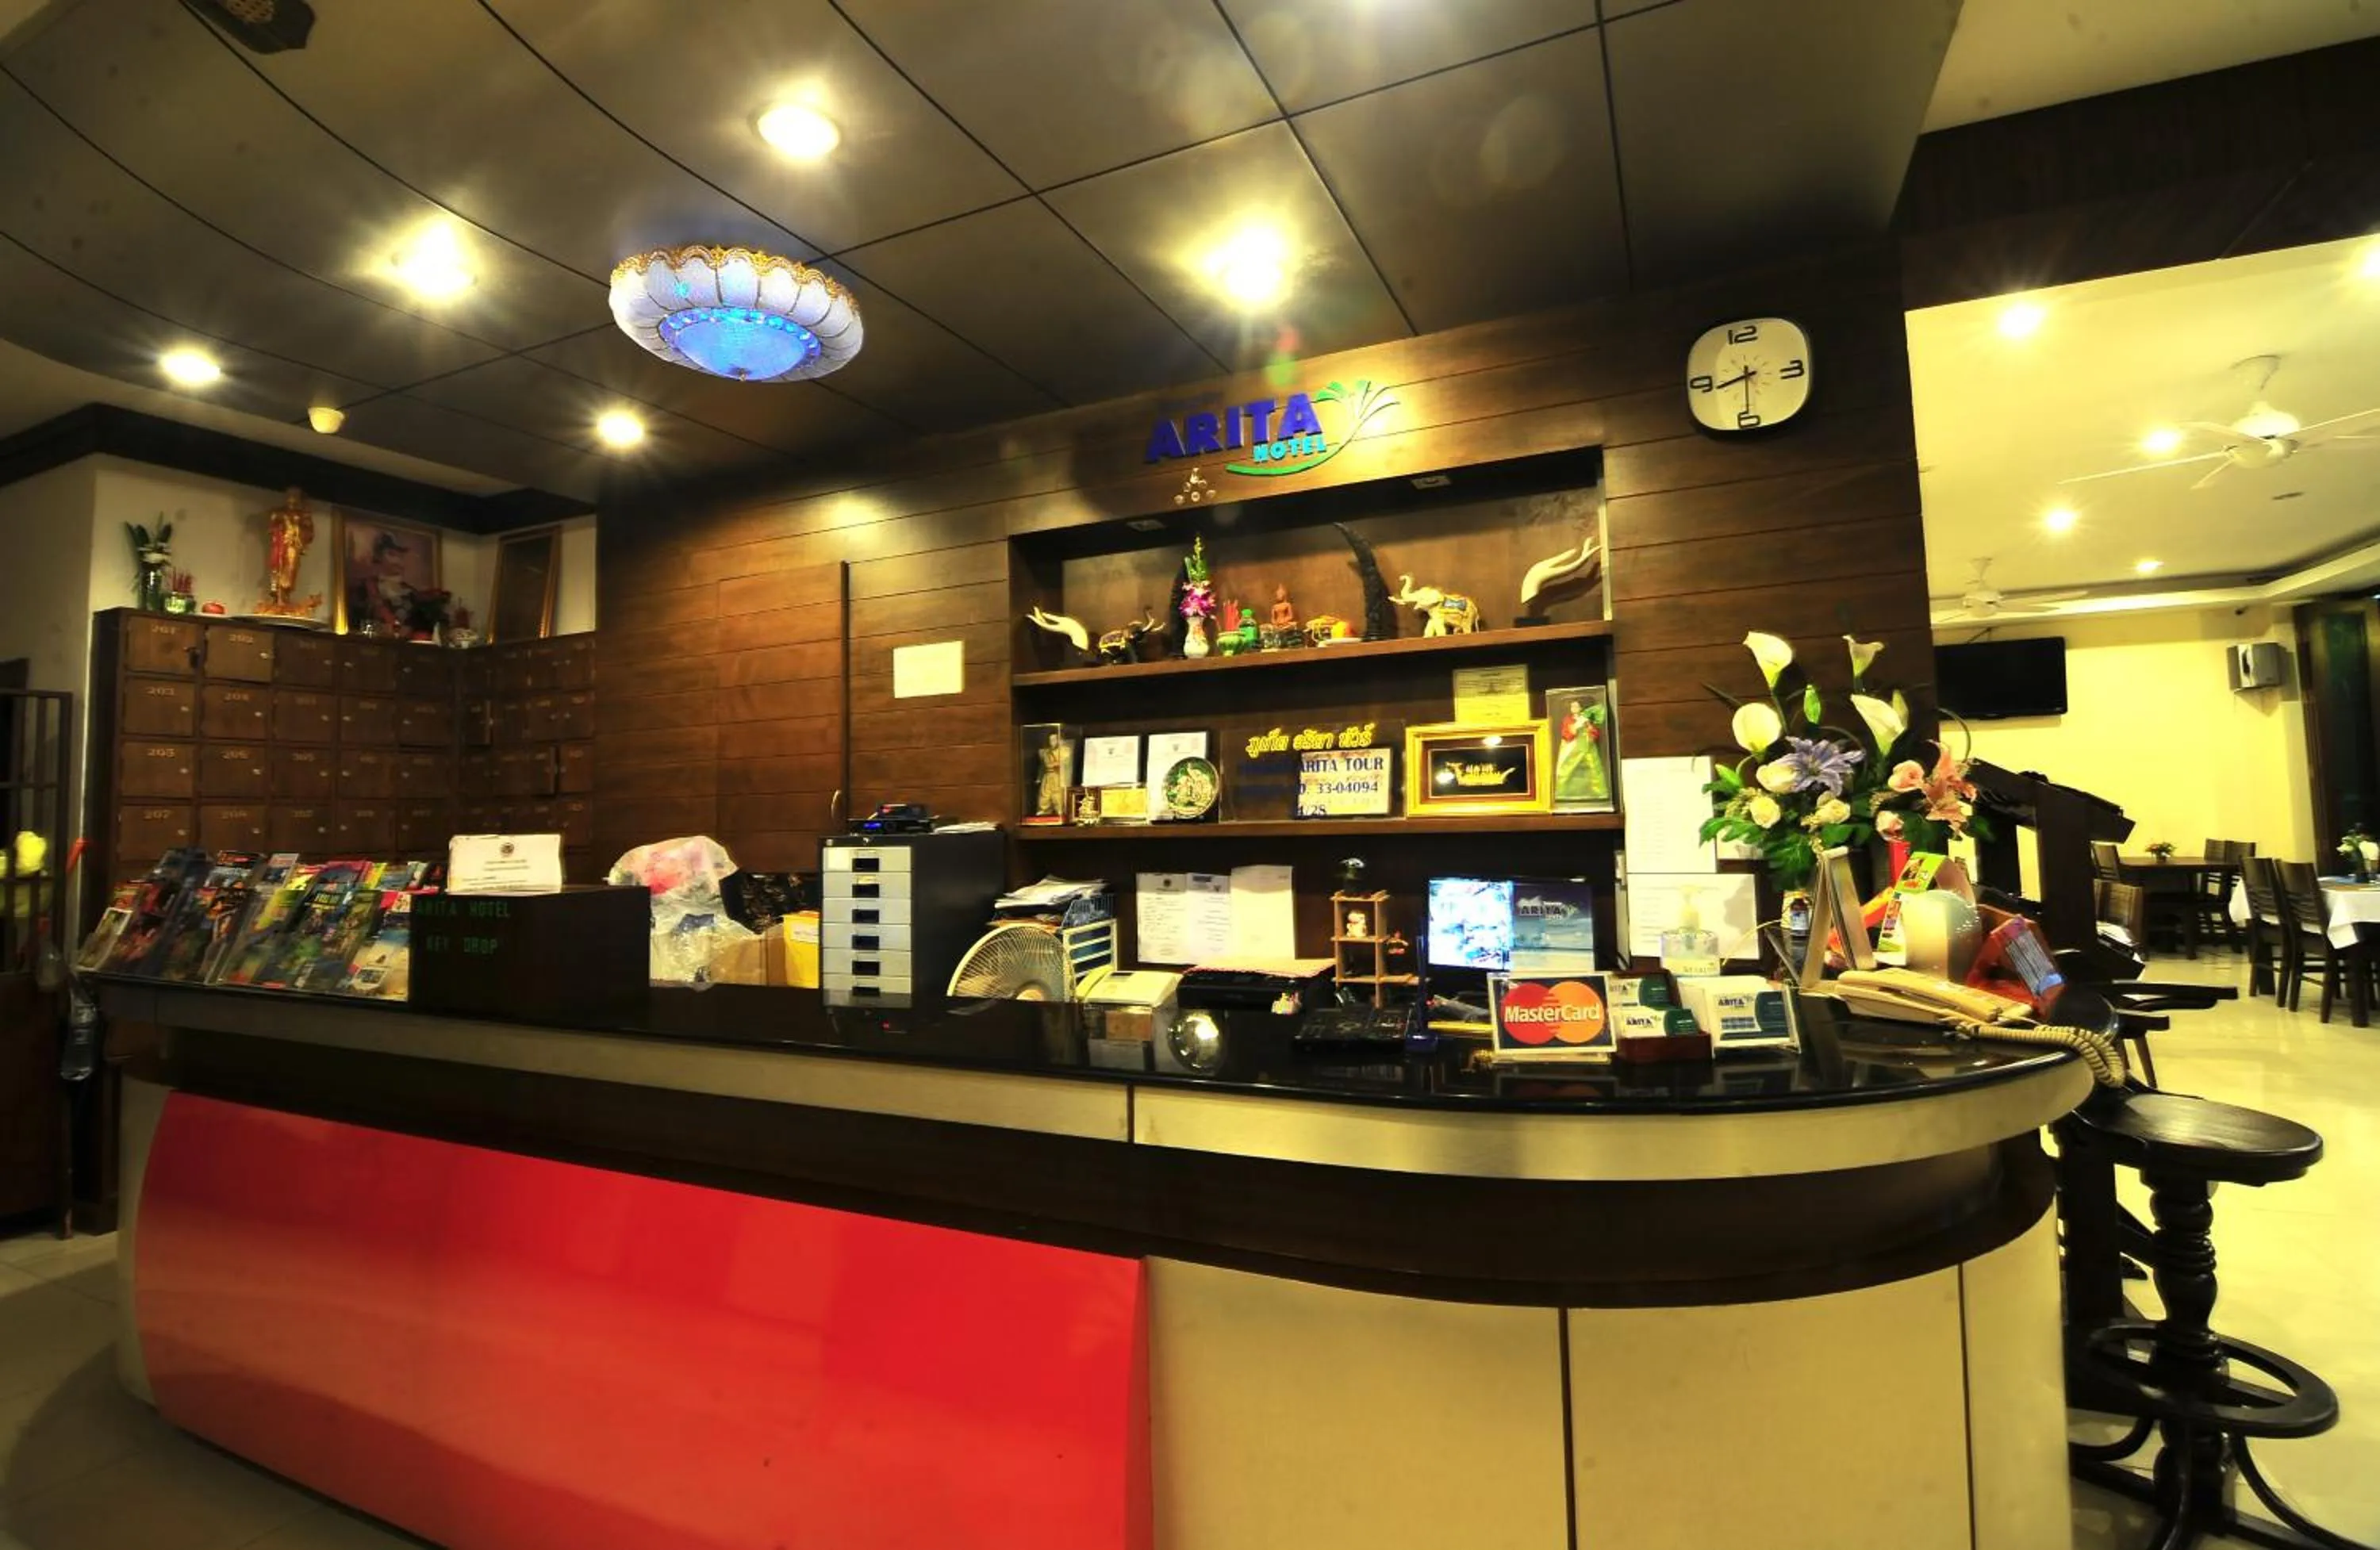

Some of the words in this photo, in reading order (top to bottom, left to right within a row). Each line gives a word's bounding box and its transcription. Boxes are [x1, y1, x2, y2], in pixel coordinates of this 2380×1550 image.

[1727, 325, 1758, 345] 12
[1779, 359, 1805, 379] 3
[1689, 375, 1713, 393] 9
[1145, 393, 1323, 463] ARITA
[1253, 434, 1327, 463] HOTEL
[1345, 757, 1384, 772] TOUR
[1319, 781, 1379, 794] 33-04094
[469, 900, 511, 918] HOTEL
[463, 936, 498, 955] DROP
[1503, 1002, 1600, 1022] MasterCard
